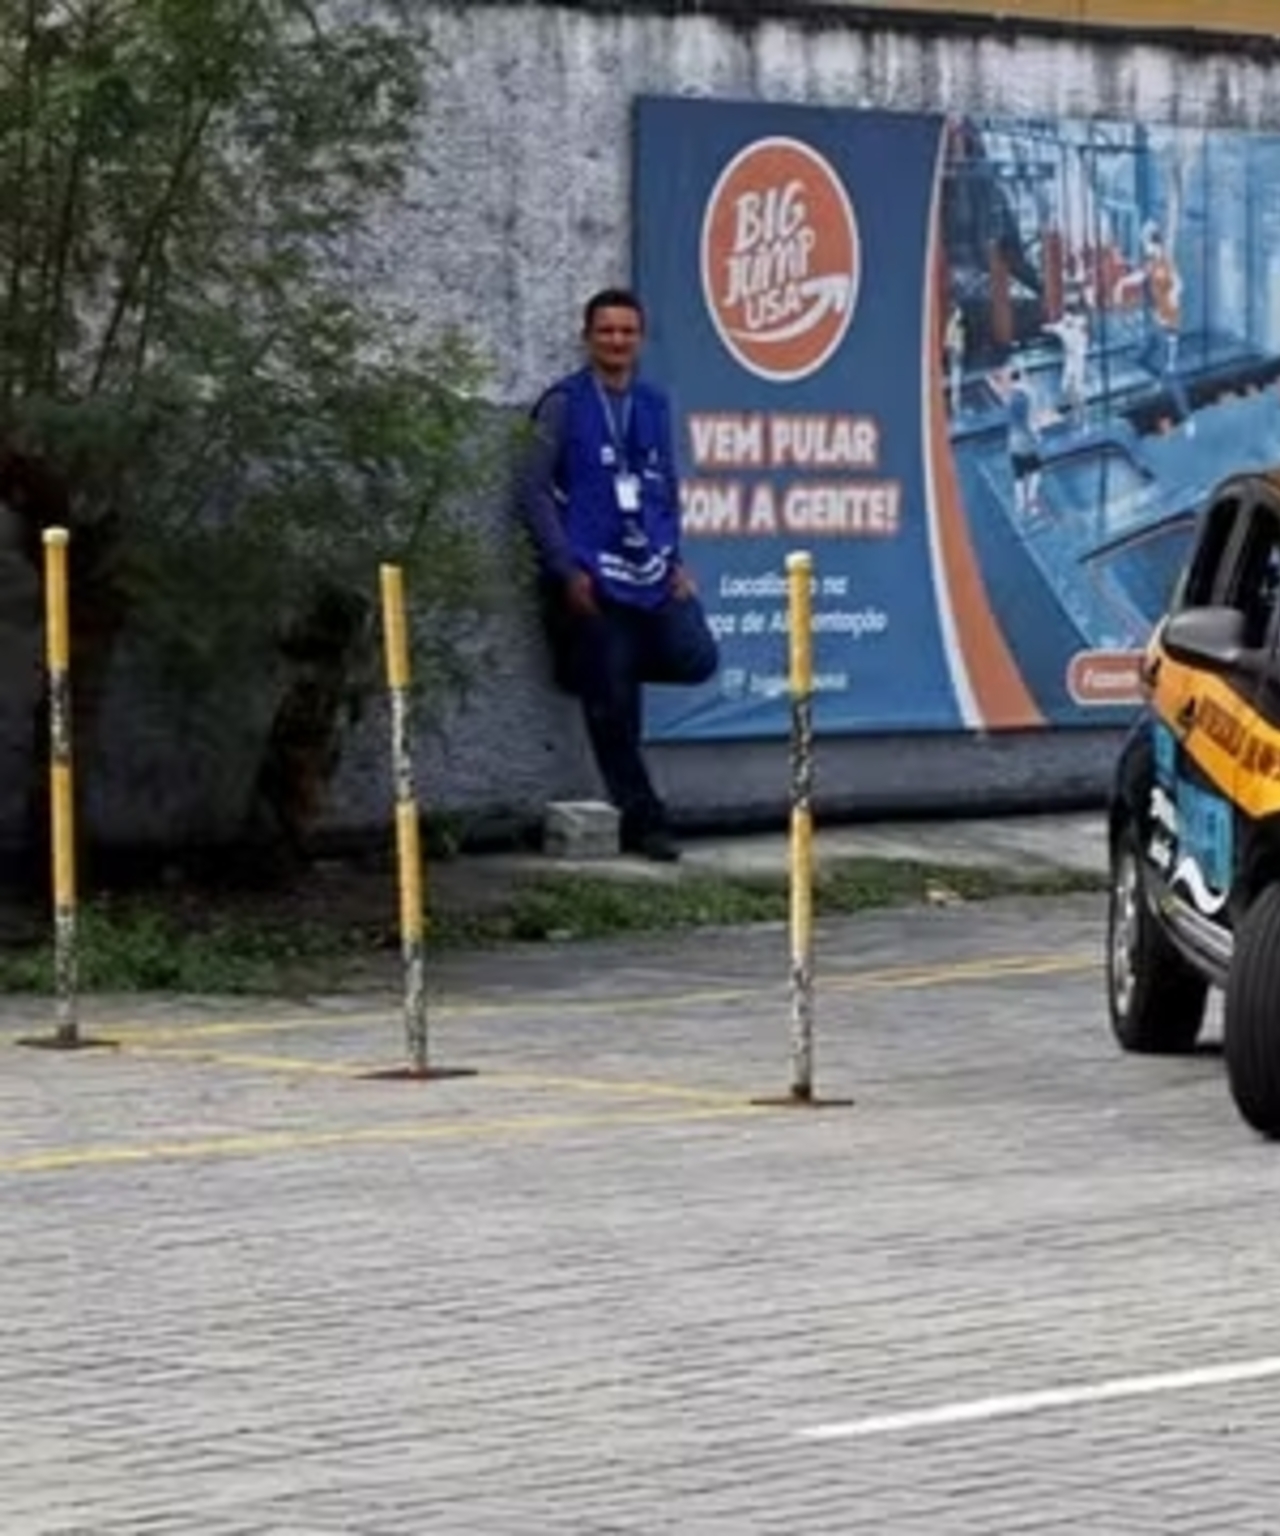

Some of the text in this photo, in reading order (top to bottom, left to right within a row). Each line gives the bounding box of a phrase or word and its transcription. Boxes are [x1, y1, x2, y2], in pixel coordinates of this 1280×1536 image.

[735, 180, 806, 252] BIG
[723, 226, 816, 307] JUMP
[745, 282, 802, 330] USA
[687, 414, 878, 465] VEM PULAR
[748, 482, 776, 532] A
[783, 481, 901, 533] GENTE!
[823, 577, 848, 596] na
[740, 611, 766, 634] de
